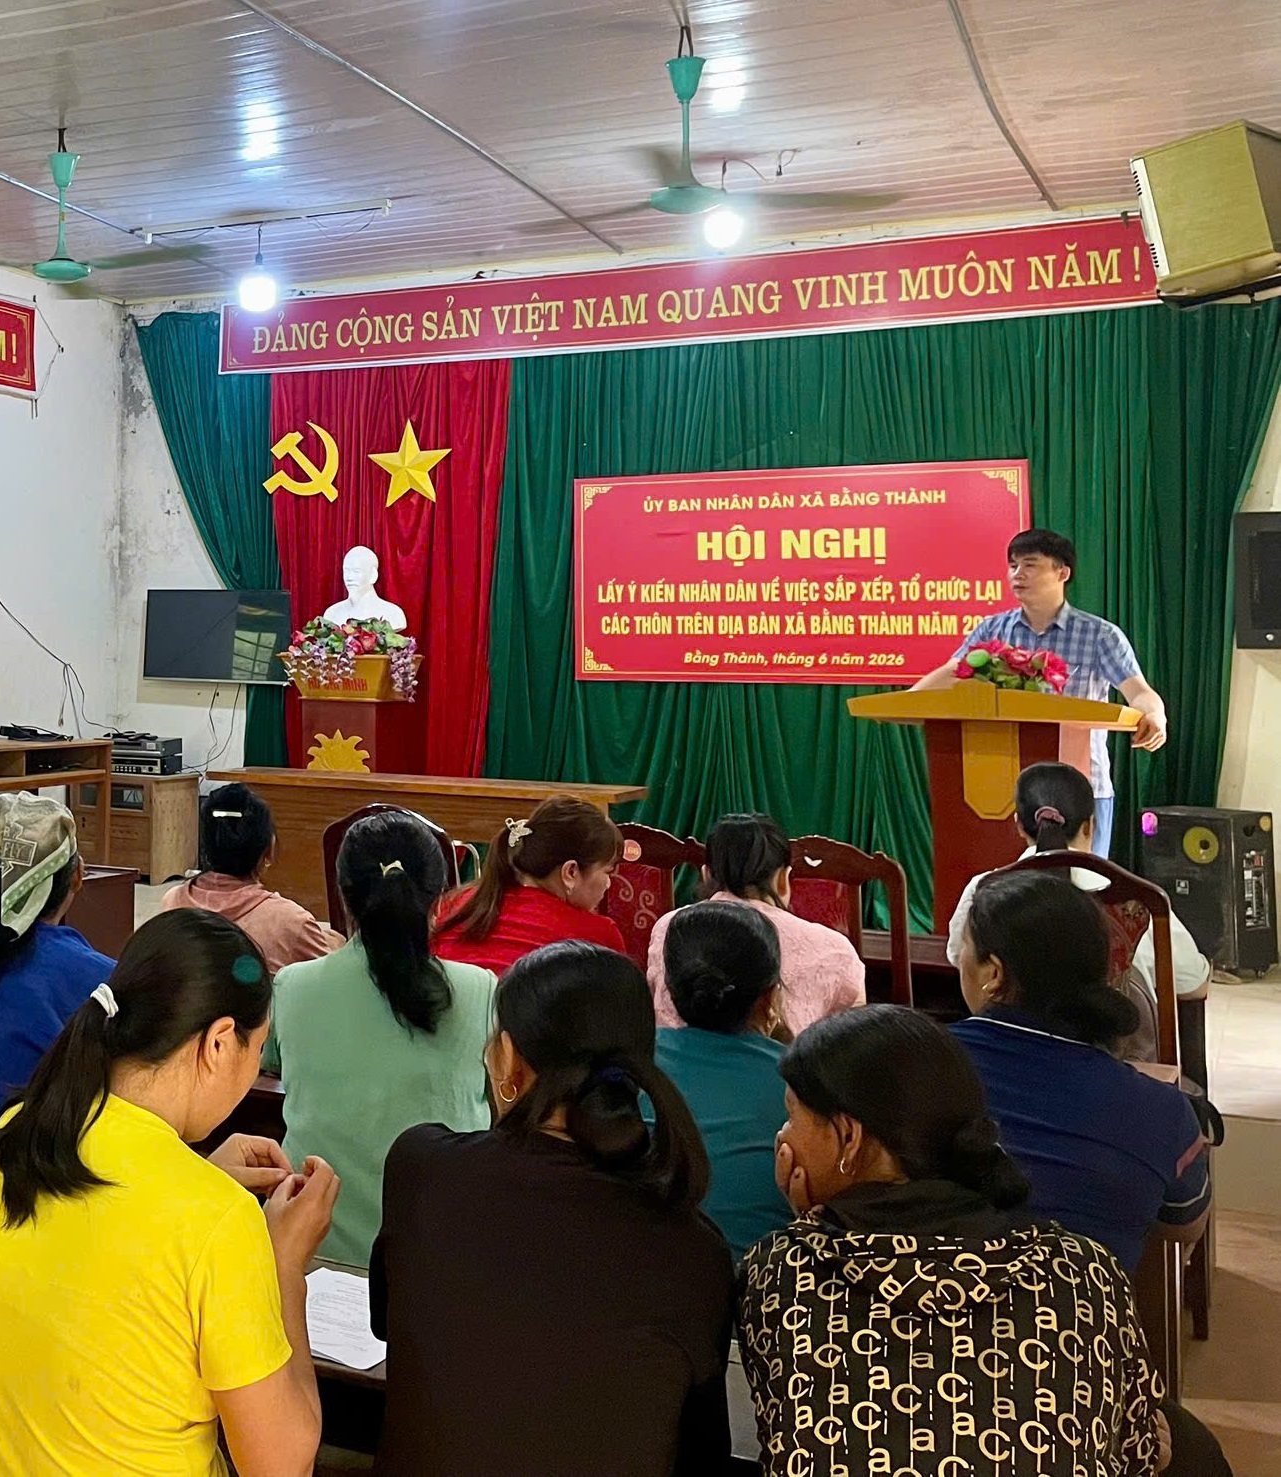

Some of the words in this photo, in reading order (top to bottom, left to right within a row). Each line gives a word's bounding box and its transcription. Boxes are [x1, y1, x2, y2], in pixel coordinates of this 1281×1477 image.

[252, 309, 329, 354] ĐẢNG
[336, 307, 414, 353] CỘNG
[422, 295, 483, 341] SẢN
[491, 292, 564, 341] VIỆT
[573, 294, 649, 330] NAM
[657, 281, 782, 324] QUANG
[792, 271, 888, 310] VINH
[898, 250, 1015, 302] MUÔN
[1027, 242, 1122, 291] NĂM
[643, 494, 664, 513] ỦY
[668, 498, 702, 512] BAN
[706, 493, 754, 511] NHÂN
[759, 491, 795, 509] DÂN
[799, 490, 825, 508] XÃ
[829, 486, 880, 508] BẰNG
[884, 487, 947, 505] THÀNH
[697, 524, 766, 567] HỘI
[781, 527, 887, 565] NGHỊ
[597, 579, 625, 603] LẤY
[627, 580, 638, 602] Ý
[640, 579, 675, 602] KIẾN
[679, 579, 721, 602] NHÂN
[725, 578, 757, 602] DÂN
[760, 576, 781, 601] VỀ
[784, 578, 820, 605] VIỆC
[824, 575, 856, 601] SẮP
[861, 575, 895, 604] XẾP,
[899, 573, 921, 601] TỔ
[925, 576, 970, 601] CHỨC
[975, 580, 1002, 605] LẠI
[602, 612, 630, 634] CÁC
[634, 612, 672, 634] THÔN
[676, 612, 714, 634] TRÊN
[717, 616, 744, 638] ĐỊA
[748, 612, 780, 634] BÀN
[785, 612, 806, 634] XÃ
[811, 608, 855, 634] BẰNG
[858, 611, 913, 635] THÀNH
[918, 611, 958, 635] NĂM
[684, 650, 719, 666] Bằng
[724, 651, 768, 666] Thành,
[773, 651, 814, 667] tháng
[819, 653, 827, 664] 6
[832, 653, 864, 665] năm
[868, 653, 904, 665] 2026
